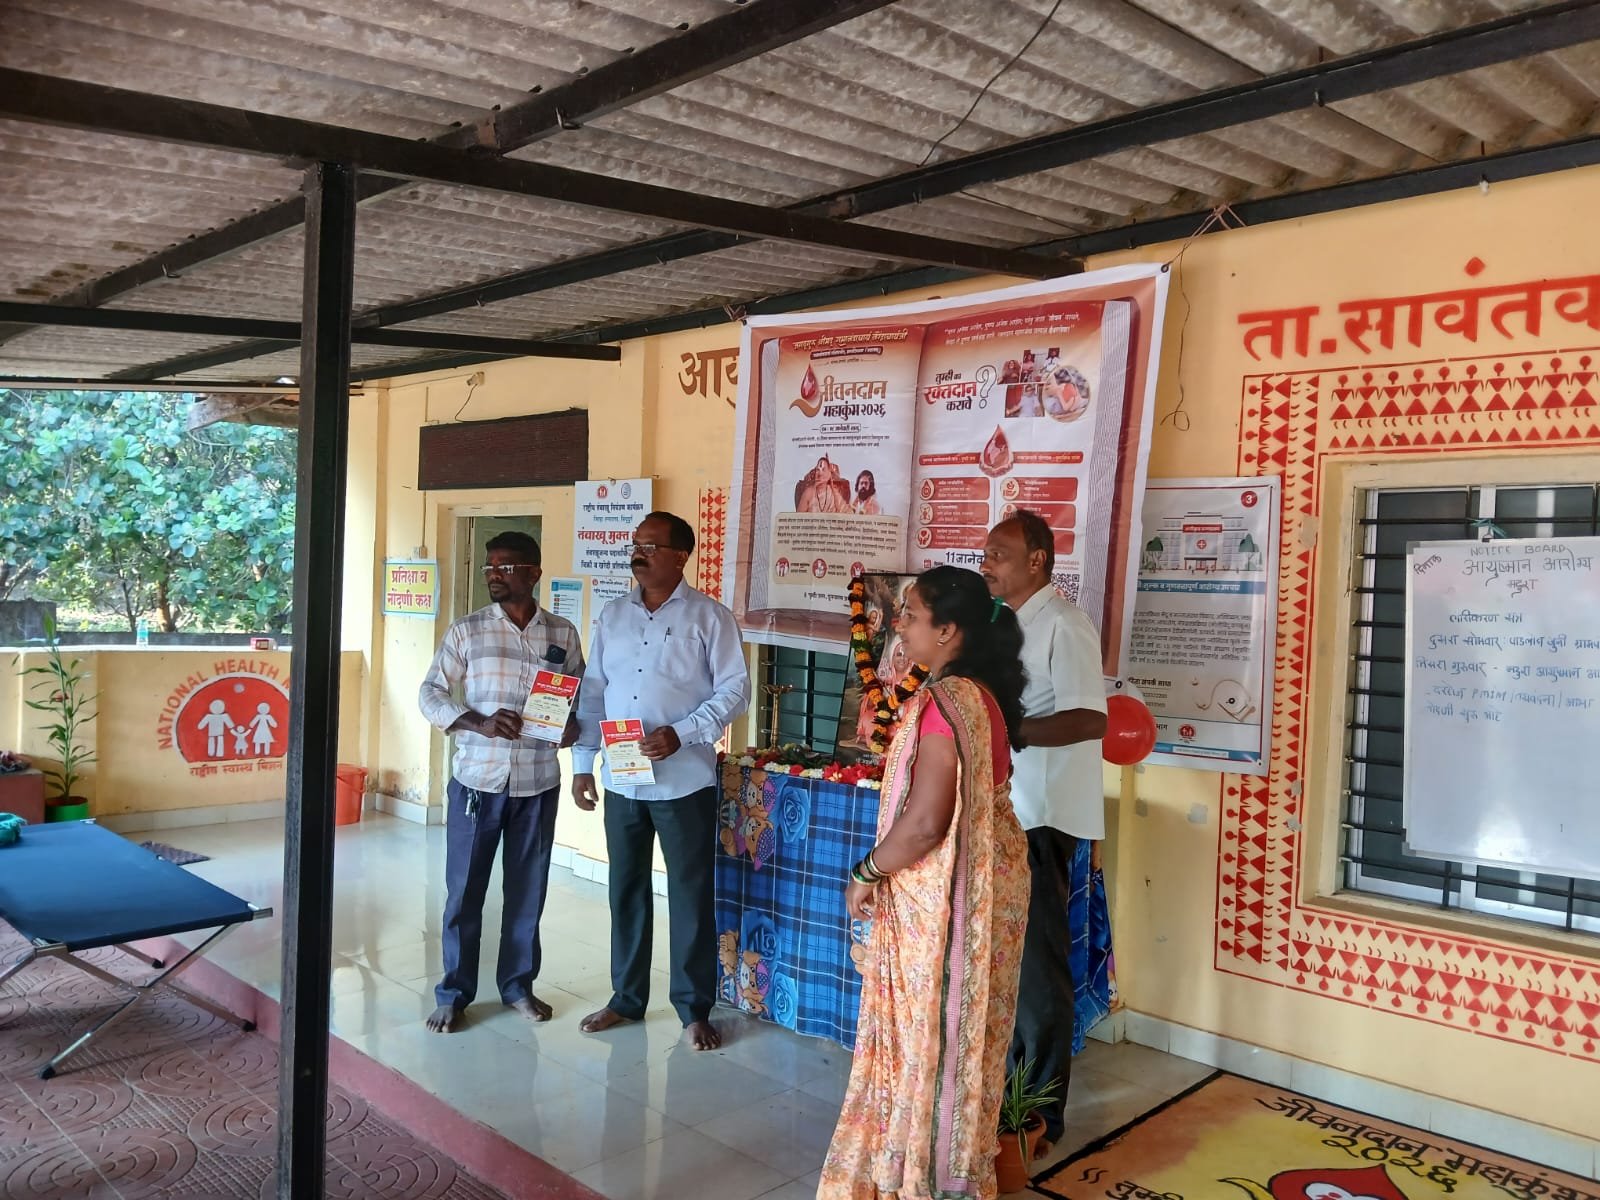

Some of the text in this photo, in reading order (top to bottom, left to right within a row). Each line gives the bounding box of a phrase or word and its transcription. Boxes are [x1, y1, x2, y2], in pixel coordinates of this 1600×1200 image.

[935, 368, 962, 385] तुम्ही का
[923, 381, 977, 405] रक्तदान
[823, 400, 887, 421] महाकुंभ २०२६
[945, 396, 973, 411] करावे
[1244, 494, 1254, 505] 3
[608, 530, 629, 545] मुक्त
[1524, 545, 1566, 554] BOARD
[391, 566, 428, 585] प्रतिक्षा व
[414, 593, 432, 609] कक्ष
[157, 659, 280, 750] NATIONAL HEALTH
[1254, 1095, 1443, 1158] जीवनदान
[1321, 1135, 1459, 1194] २०२६
